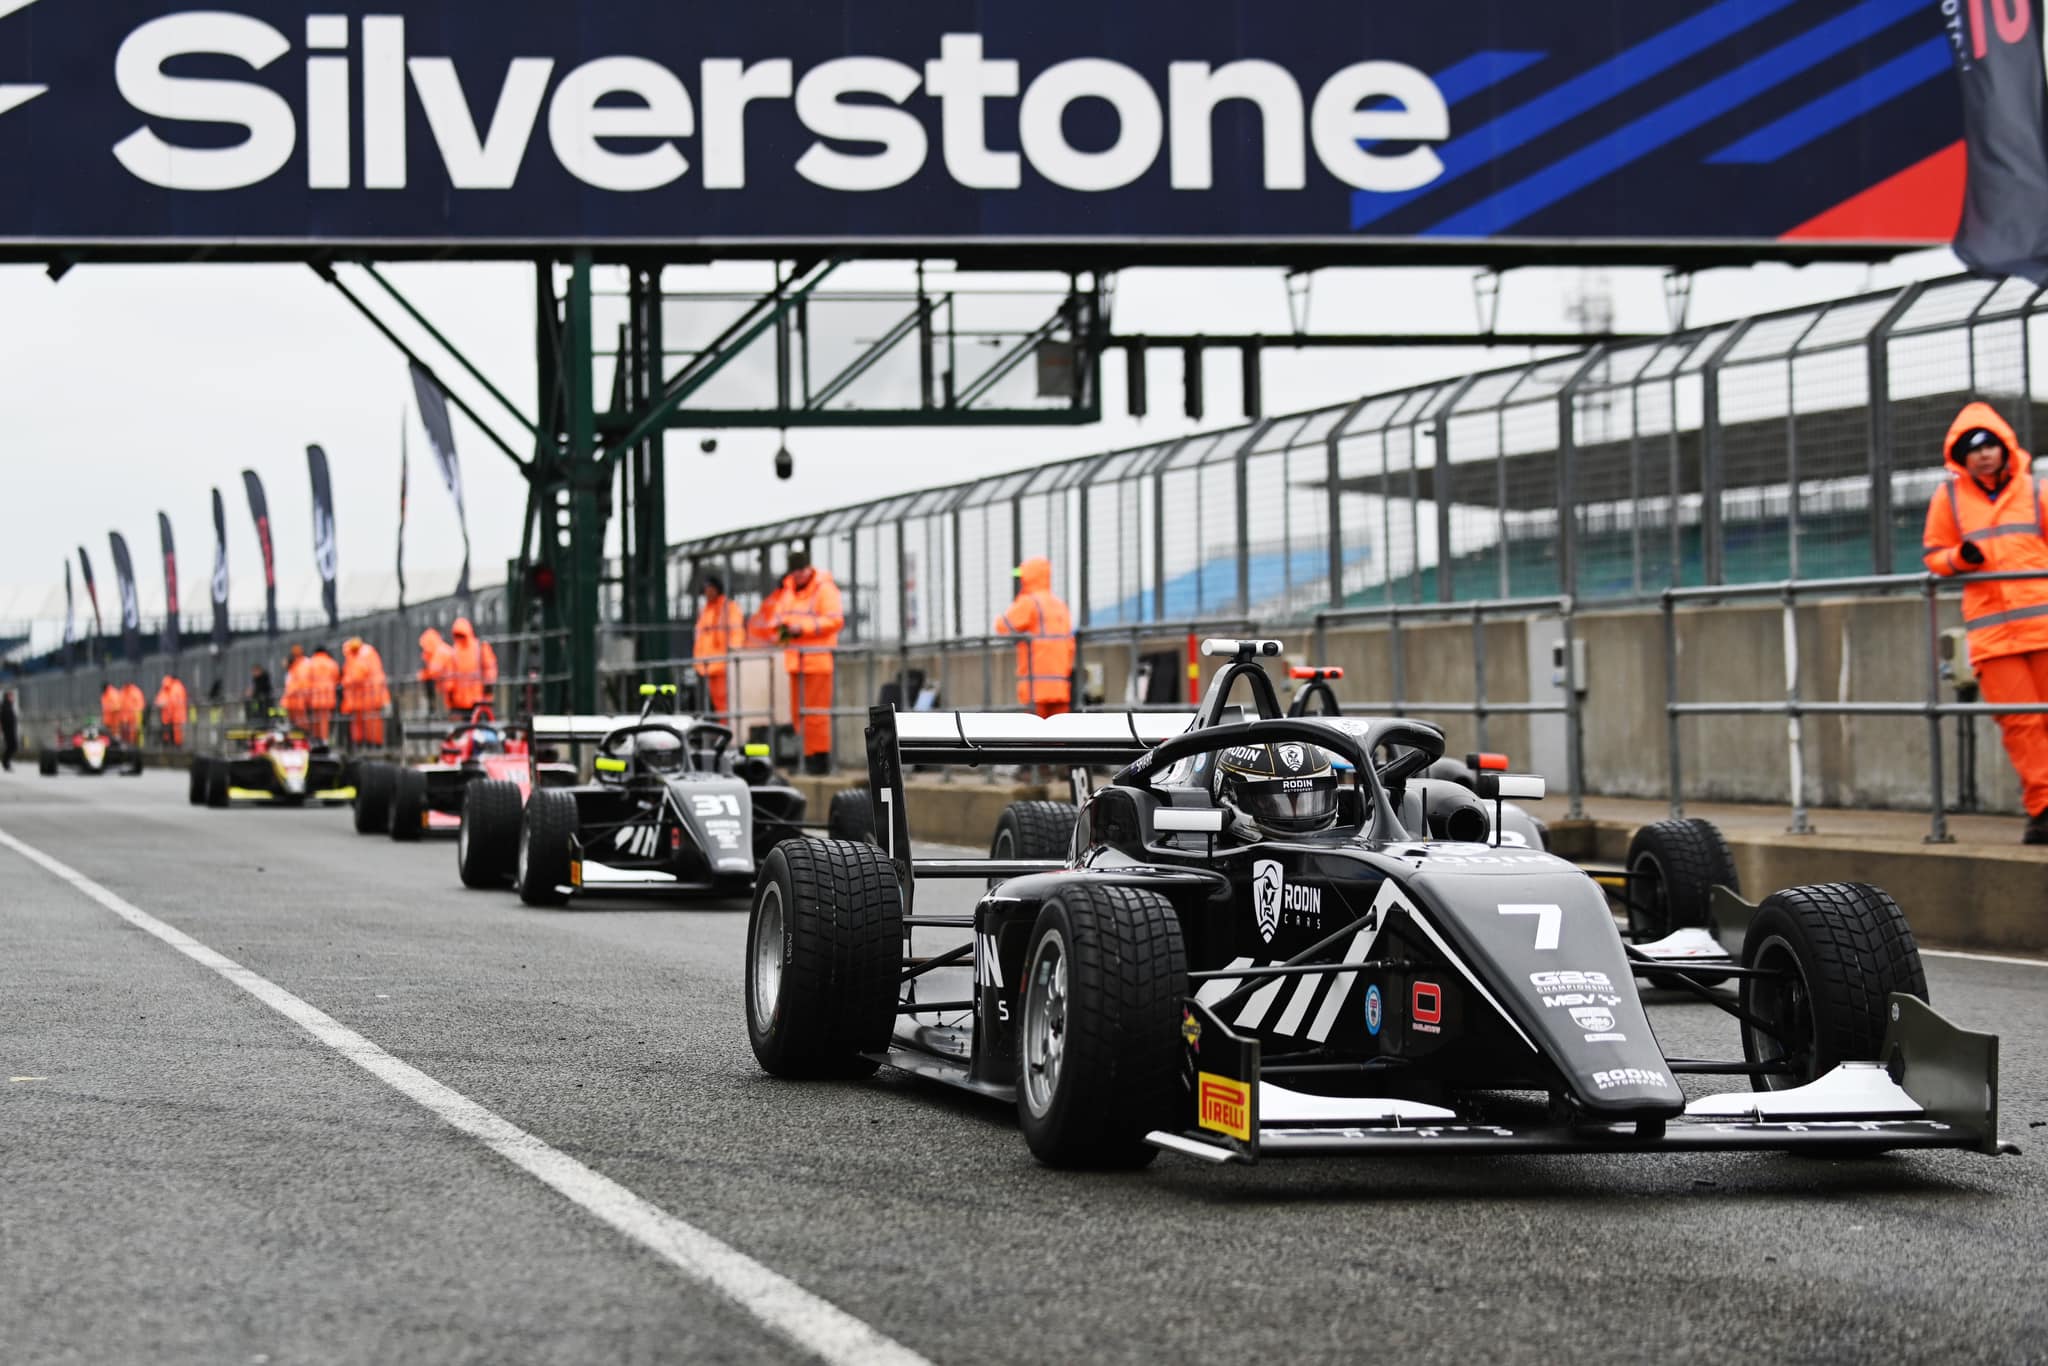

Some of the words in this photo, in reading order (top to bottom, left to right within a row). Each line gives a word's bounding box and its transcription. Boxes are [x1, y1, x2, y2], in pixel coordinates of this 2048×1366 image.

[113, 12, 1449, 192] Silverstone
[1283, 779, 1313, 789] RODIN
[692, 794, 741, 816] 31
[1284, 883, 1321, 914] RODIN
[1284, 913, 1321, 930] CARS
[1497, 903, 1562, 950] 7
[1529, 971, 1611, 986] GB3
[1536, 984, 1616, 994] CHAMPIONSHIP
[1542, 993, 1595, 1008] MSV
[1592, 1068, 1666, 1085] RODIN
[1599, 1079, 1668, 1090] MOTORSPORT
[1201, 1080, 1245, 1131] PIRELLI
